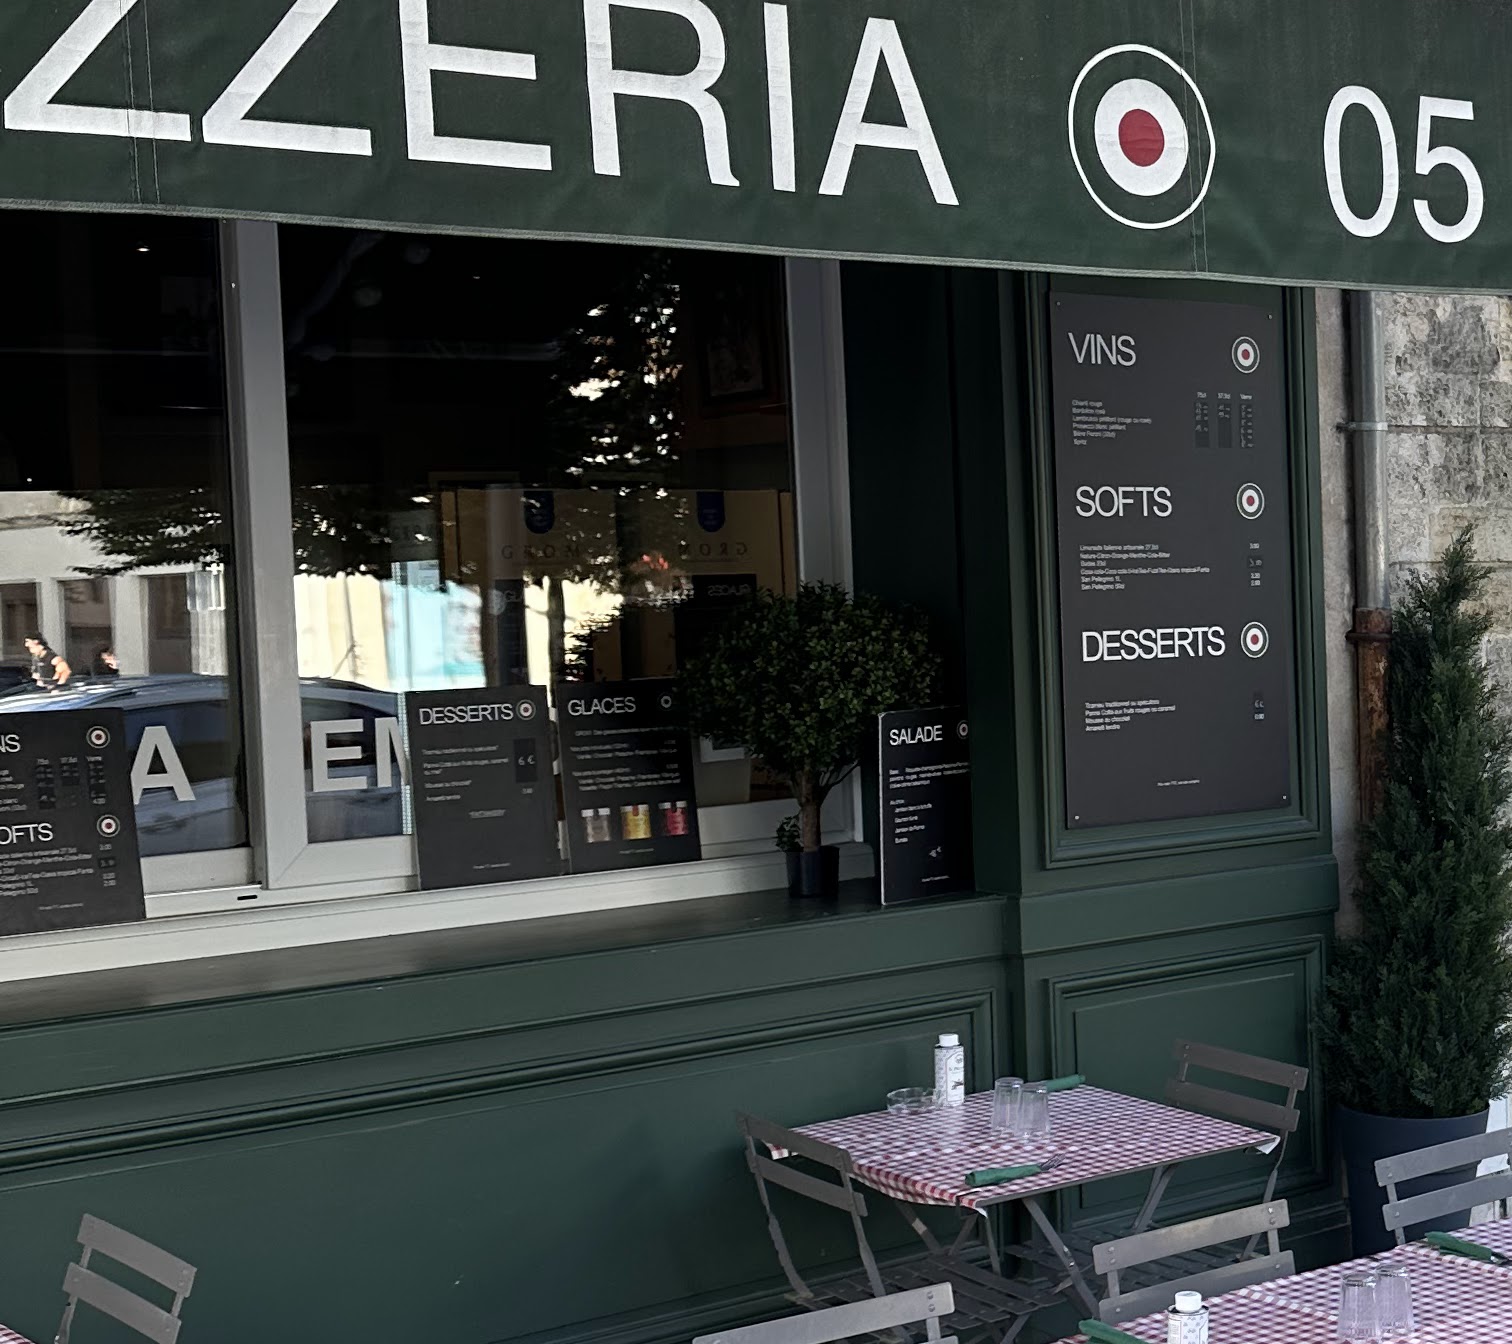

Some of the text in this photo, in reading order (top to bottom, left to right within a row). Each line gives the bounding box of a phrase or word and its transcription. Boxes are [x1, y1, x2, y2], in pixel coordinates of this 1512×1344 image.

[1322, 84, 1484, 244] 05
[1068, 332, 1137, 367] VINS
[1075, 485, 1173, 517] SOFTS
[1081, 625, 1226, 663] DESSERTS
[419, 703, 514, 725] DESSERTS
[567, 696, 636, 716] GLACES
[889, 724, 943, 746] SALADE
